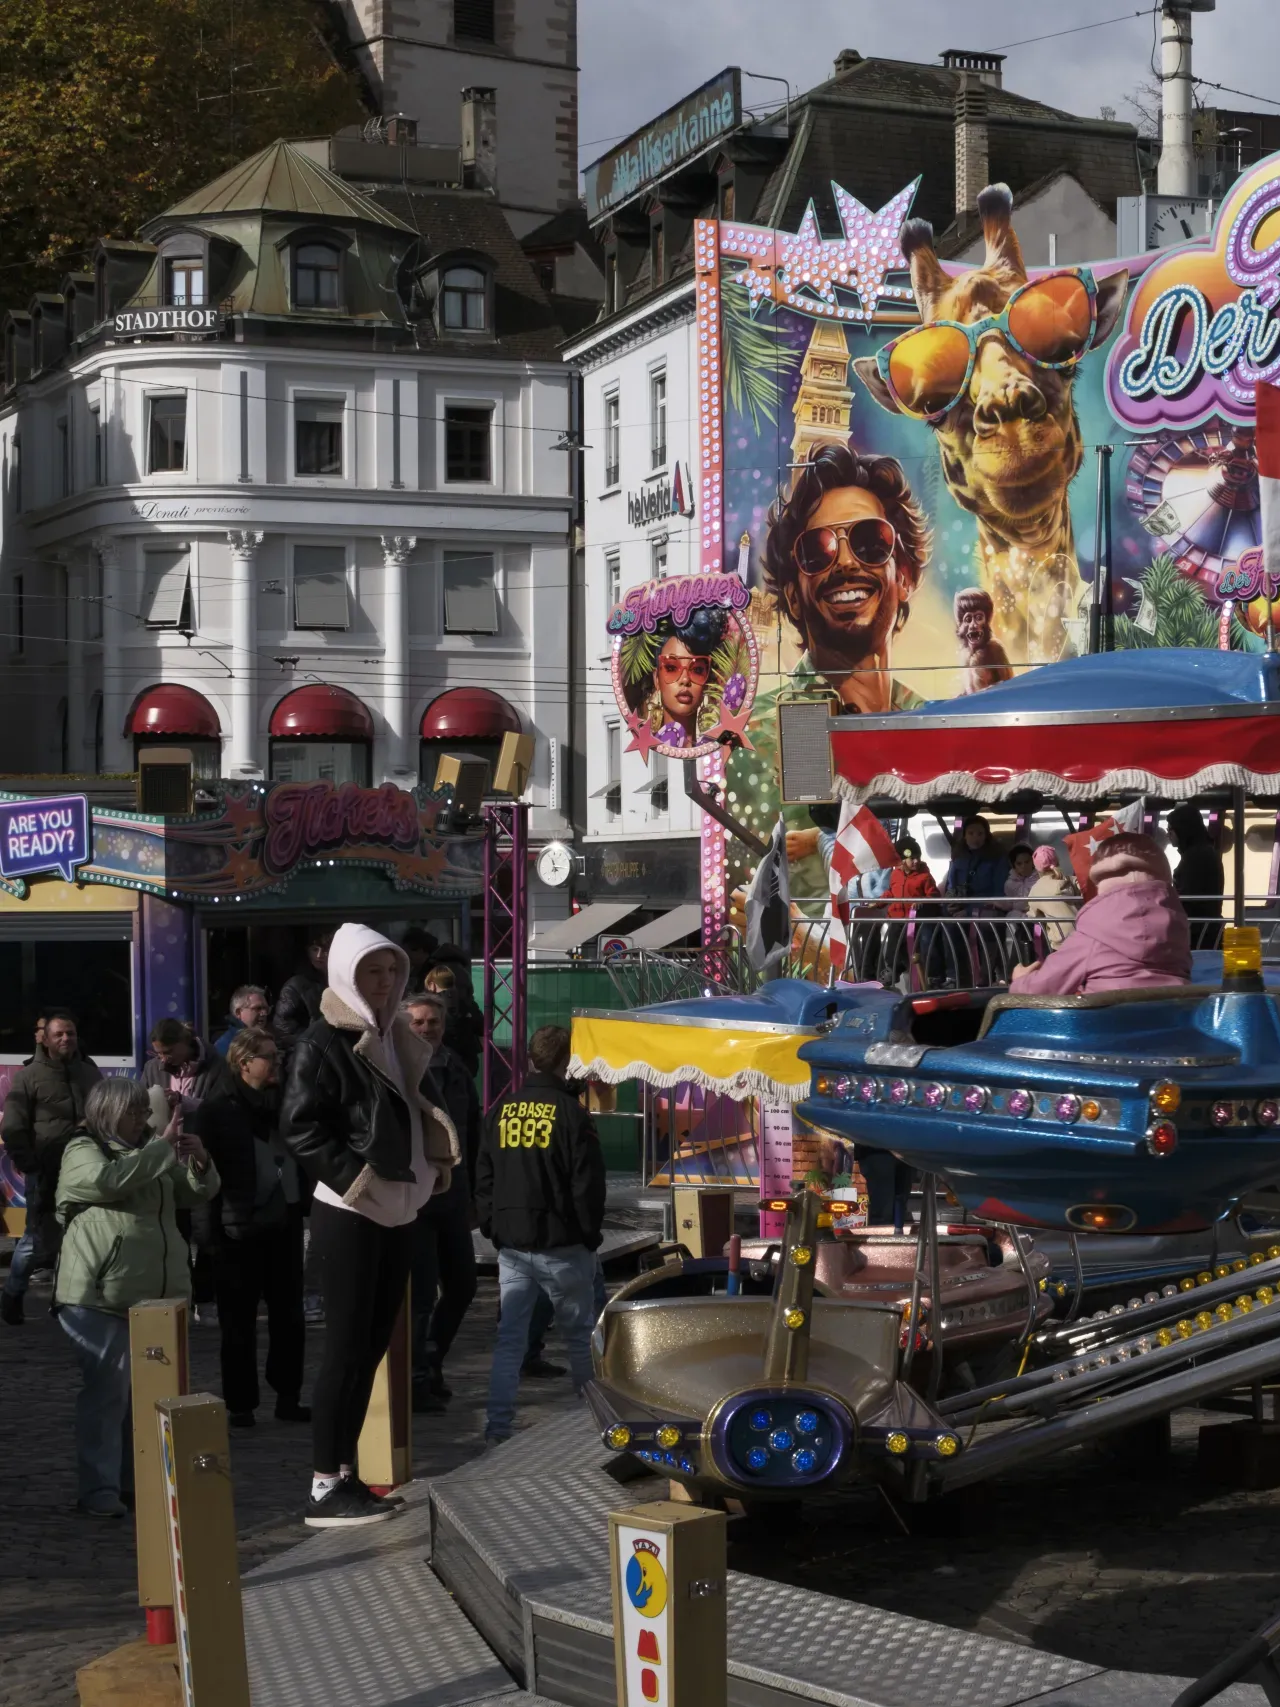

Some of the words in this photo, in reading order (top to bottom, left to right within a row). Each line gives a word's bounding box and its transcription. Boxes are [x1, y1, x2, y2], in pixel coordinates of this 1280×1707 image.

[115, 309, 218, 332] STADTHOF
[140, 501, 190, 520] Donati
[627, 477, 671, 524] helvetia
[1219, 572, 1251, 594] Der
[609, 608, 636, 630] Der
[624, 576, 746, 632] Hangover
[8, 813, 38, 835] ARE
[39, 809, 73, 830] YOU
[270, 782, 413, 867] Tickets
[8, 829, 75, 860] READY?
[501, 1102, 517, 1119] FC
[517, 1101, 557, 1120] BASEL
[497, 1117, 553, 1149] 1893
[635, 1540, 659, 1556] TAXI
